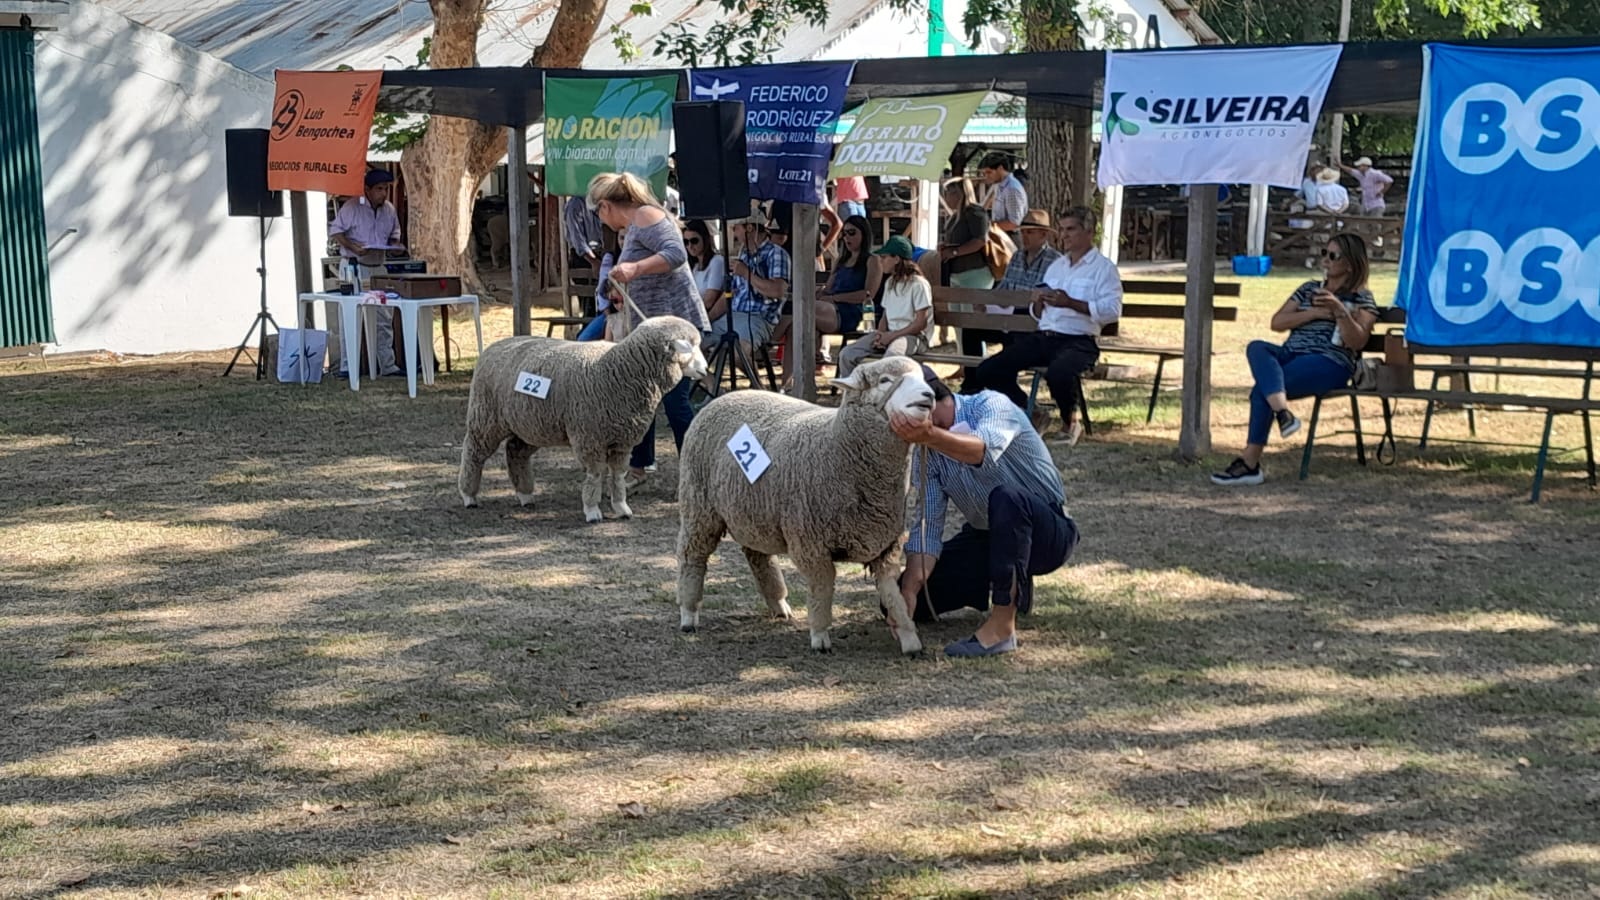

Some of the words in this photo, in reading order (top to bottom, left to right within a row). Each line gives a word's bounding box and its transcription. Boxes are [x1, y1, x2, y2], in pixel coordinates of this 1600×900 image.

[750, 85, 829, 103] FEDERICO
[304, 107, 325, 120] Luis
[746, 107, 834, 128] RODRÍGUEZ
[1148, 96, 1310, 124] SILVEIRA
[295, 125, 355, 141] Bengochea
[1160, 127, 1287, 140] AGRONEGOCIOS
[834, 141, 934, 166] DOHNE
[303, 162, 348, 175] RURALES
[1445, 246, 1600, 307] BS
[522, 377, 542, 394] 22
[734, 440, 758, 473] 21
